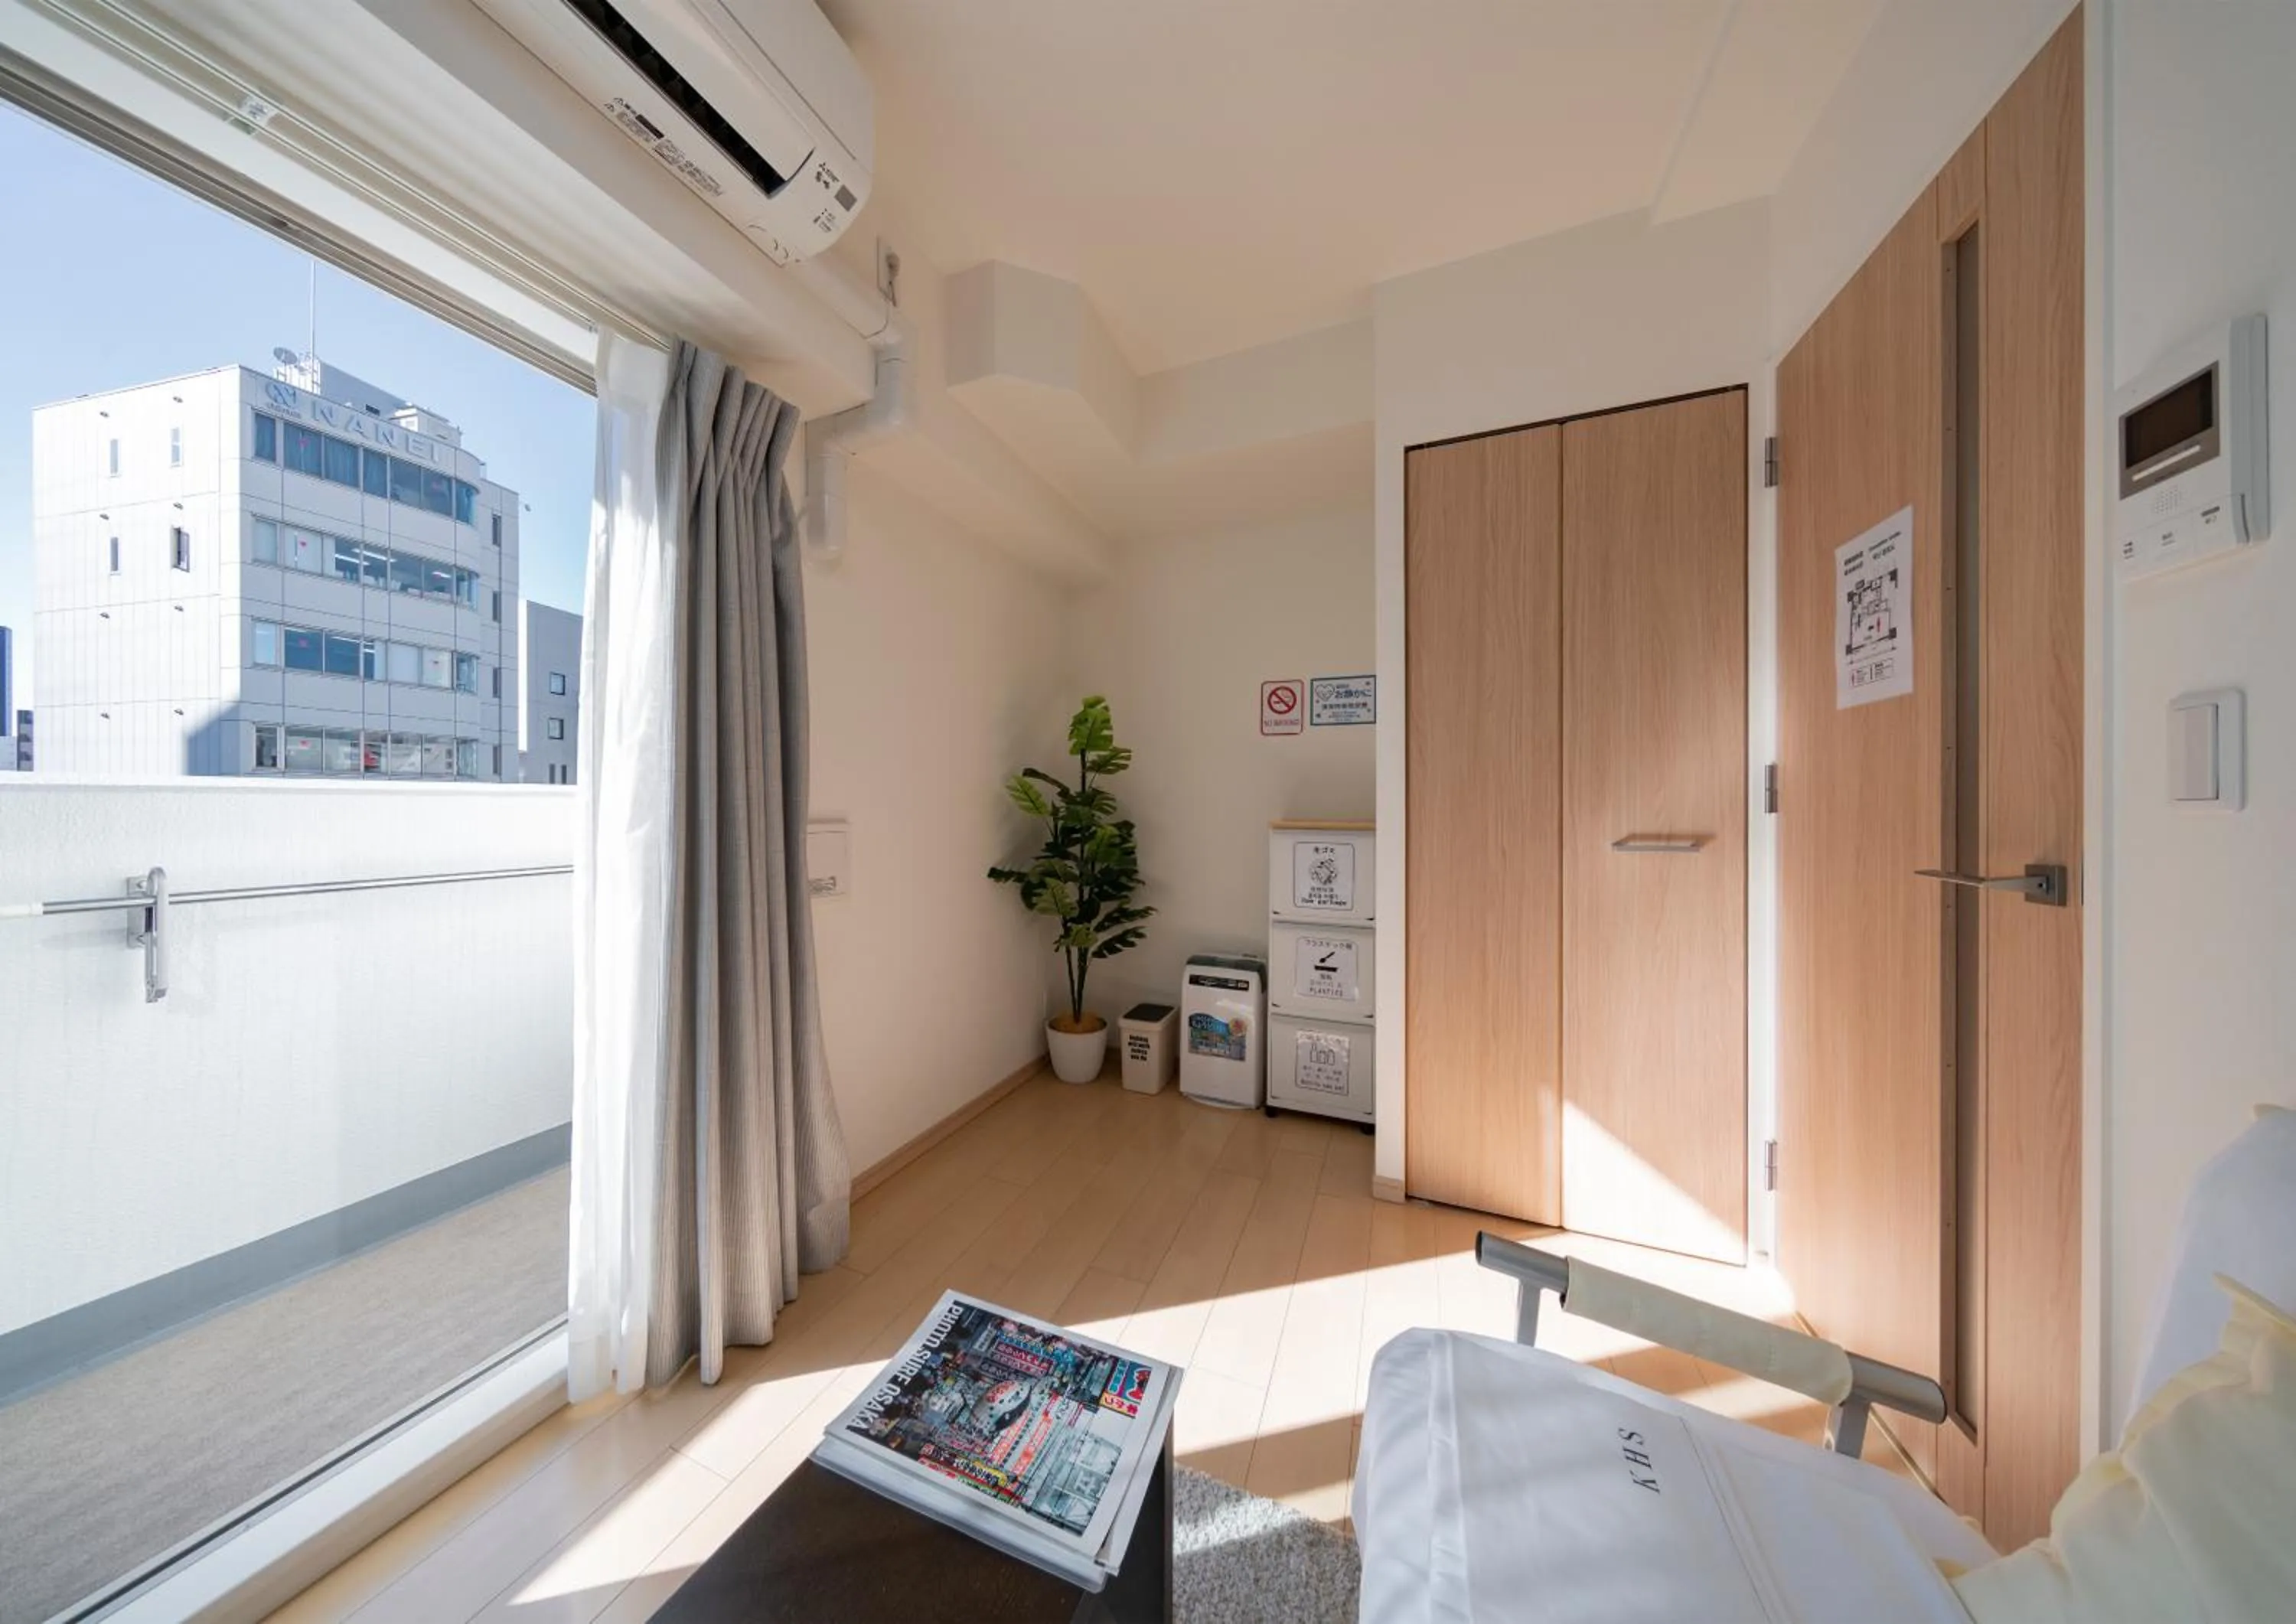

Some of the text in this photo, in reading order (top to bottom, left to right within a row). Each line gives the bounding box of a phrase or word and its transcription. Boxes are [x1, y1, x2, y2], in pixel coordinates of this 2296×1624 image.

[850, 1305, 964, 1430] PHOTO SURF OSAKA
